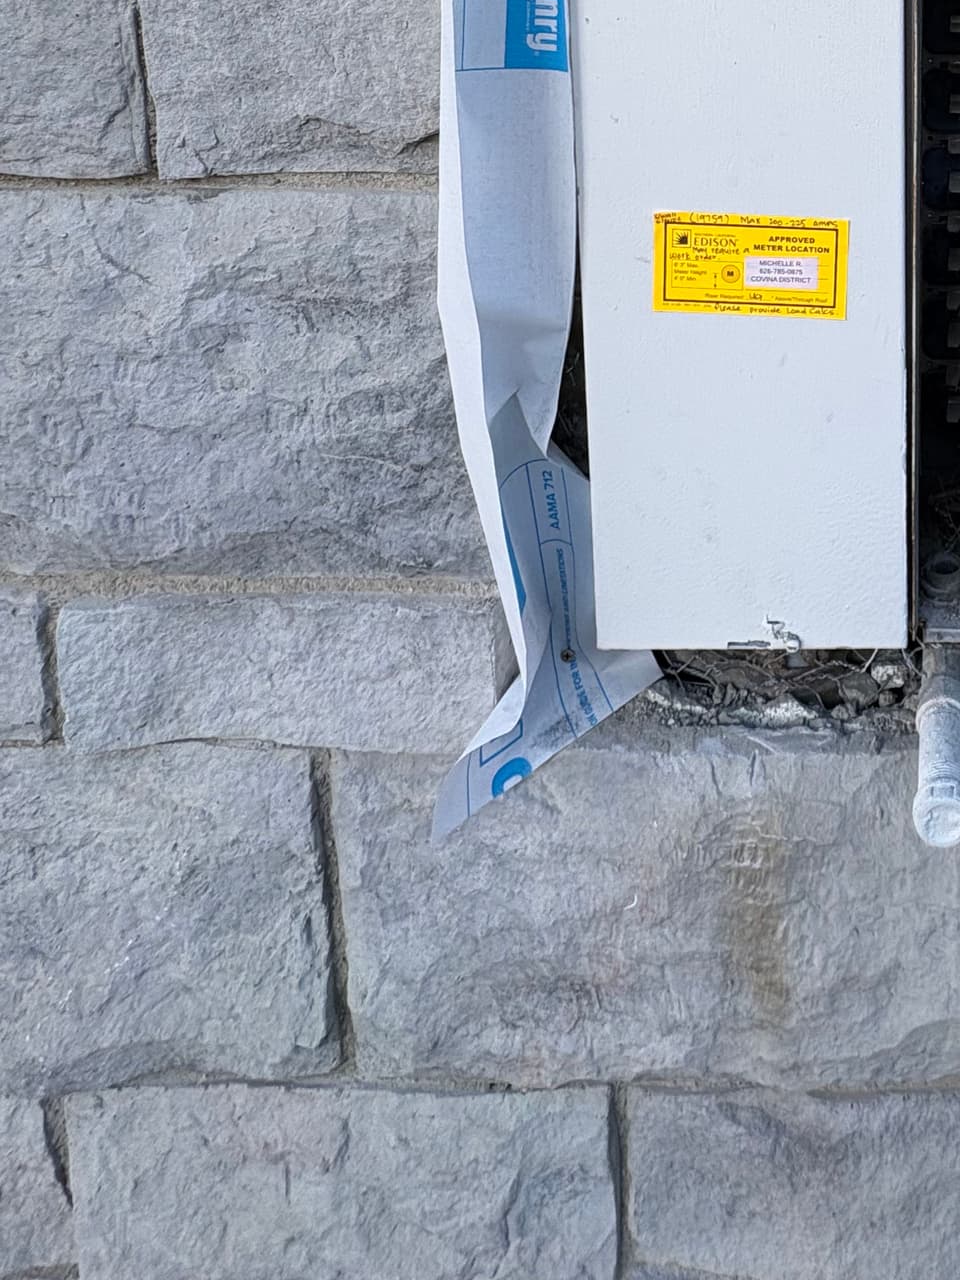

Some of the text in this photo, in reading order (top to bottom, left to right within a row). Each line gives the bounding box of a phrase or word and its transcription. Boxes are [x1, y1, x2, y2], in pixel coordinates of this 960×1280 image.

[693, 237, 737, 247] EDISON
[768, 235, 816, 244] APPROVED
[753, 244, 830, 254] METER LOCATION
[779, 276, 812, 284] DISTRICT
[544, 469, 562, 530] AAMA 712
